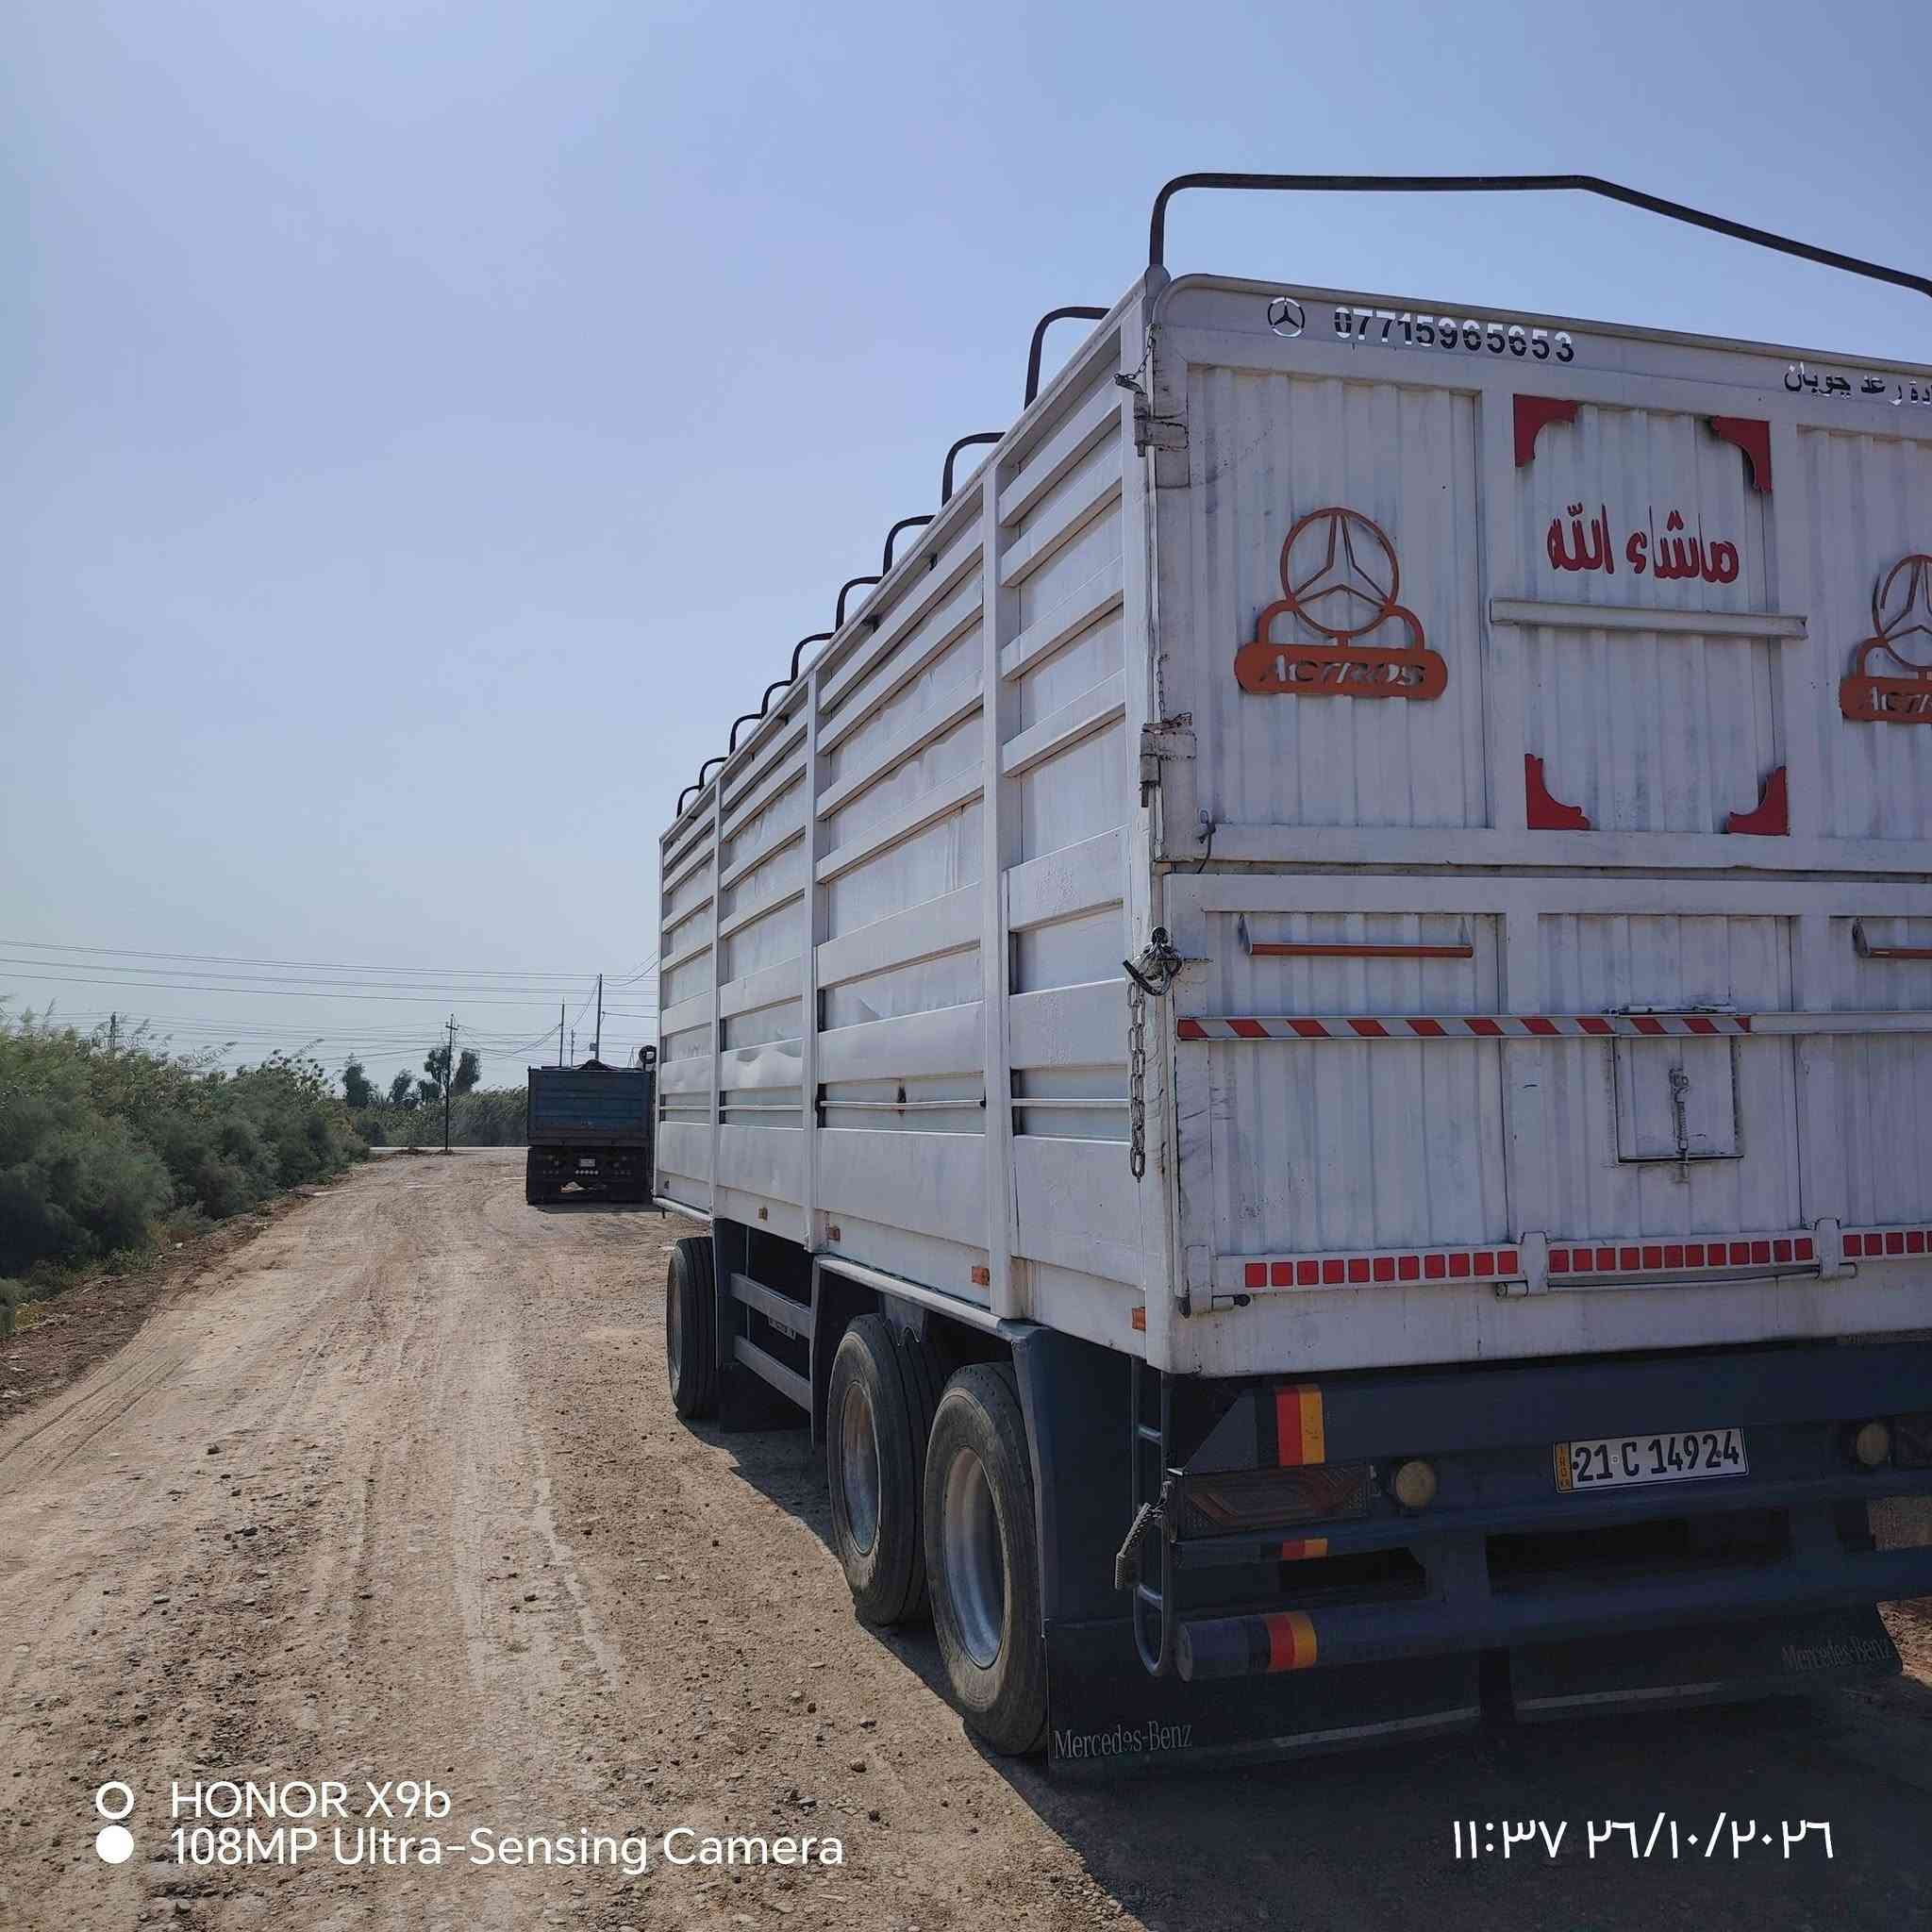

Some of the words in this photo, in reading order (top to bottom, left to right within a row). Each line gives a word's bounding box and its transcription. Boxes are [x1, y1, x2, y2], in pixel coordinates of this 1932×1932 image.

[1334, 307, 1574, 362] 07715965653
[1574, 1443, 1614, 1483] 21
[1621, 1441, 1640, 1476] C
[1648, 1430, 1740, 1474] 14924
[1054, 1720, 1192, 1759] Mercedes-Benz
